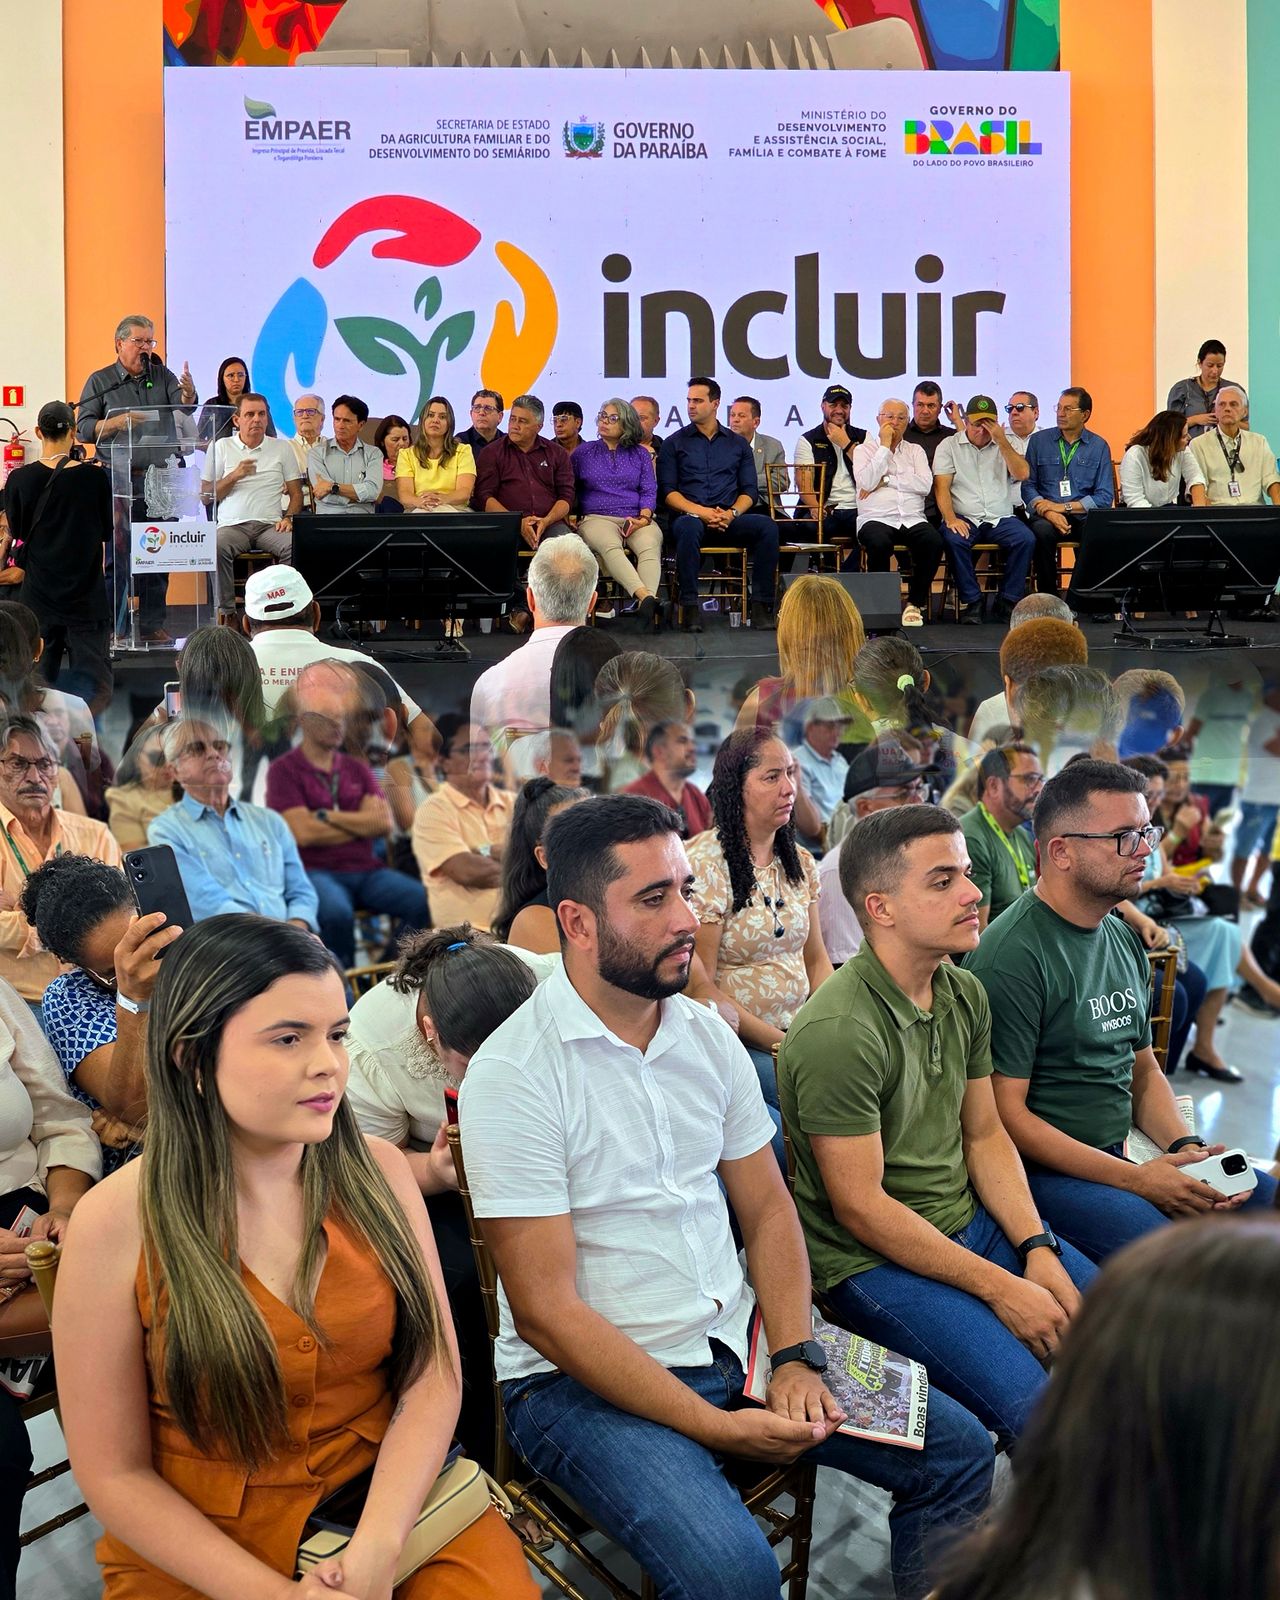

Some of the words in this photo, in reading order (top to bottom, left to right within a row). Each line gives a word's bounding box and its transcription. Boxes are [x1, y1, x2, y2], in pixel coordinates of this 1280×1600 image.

[801, 108, 867, 120] MINISTÉRIO
[870, 110, 887, 120] DO
[929, 106, 994, 116] GOVERNO
[998, 106, 1017, 116] DO
[245, 120, 351, 141] EMPAER
[436, 119, 494, 130] SECRETARIA
[496, 119, 509, 130] DE
[512, 119, 550, 130] ESTADO
[613, 122, 694, 139] GOVERNO
[777, 123, 887, 132] DESENVOLVIMENTO
[380, 133, 396, 144] DA
[398, 133, 471, 144] AGRICULTURA
[473, 133, 522, 144] FAMILIAR
[525, 133, 532, 144] E
[534, 133, 550, 144] DO
[753, 135, 760, 145] E
[763, 133, 838, 145] ASSISTÊNCIA
[841, 136, 886, 146] SOCIAL,
[904, 119, 1043, 155] BRASIL
[369, 148, 471, 159] DESENVOLVIMENTO
[473, 148, 489, 159] DO
[492, 146, 550, 159] SEMIÁRIDO
[613, 142, 636, 159] DA
[640, 139, 708, 159] PARAÍBA
[728, 147, 774, 158] FAMÍLIA
[777, 148, 784, 158] E
[787, 148, 842, 158] COMBATE
[844, 147, 852, 158] À
[856, 148, 887, 158] FOME
[601, 252, 1007, 380] incluir
[169, 531, 206, 544] incluir
[266, 588, 286, 600] MAB
[270, 667, 276, 676] E
[1088, 987, 1137, 1020] BOOS
[858, 1340, 871, 1370] TODOS
[866, 1344, 882, 1387] ATINGID
[916, 1370, 928, 1403] vindas
[913, 1406, 926, 1438] Boas
